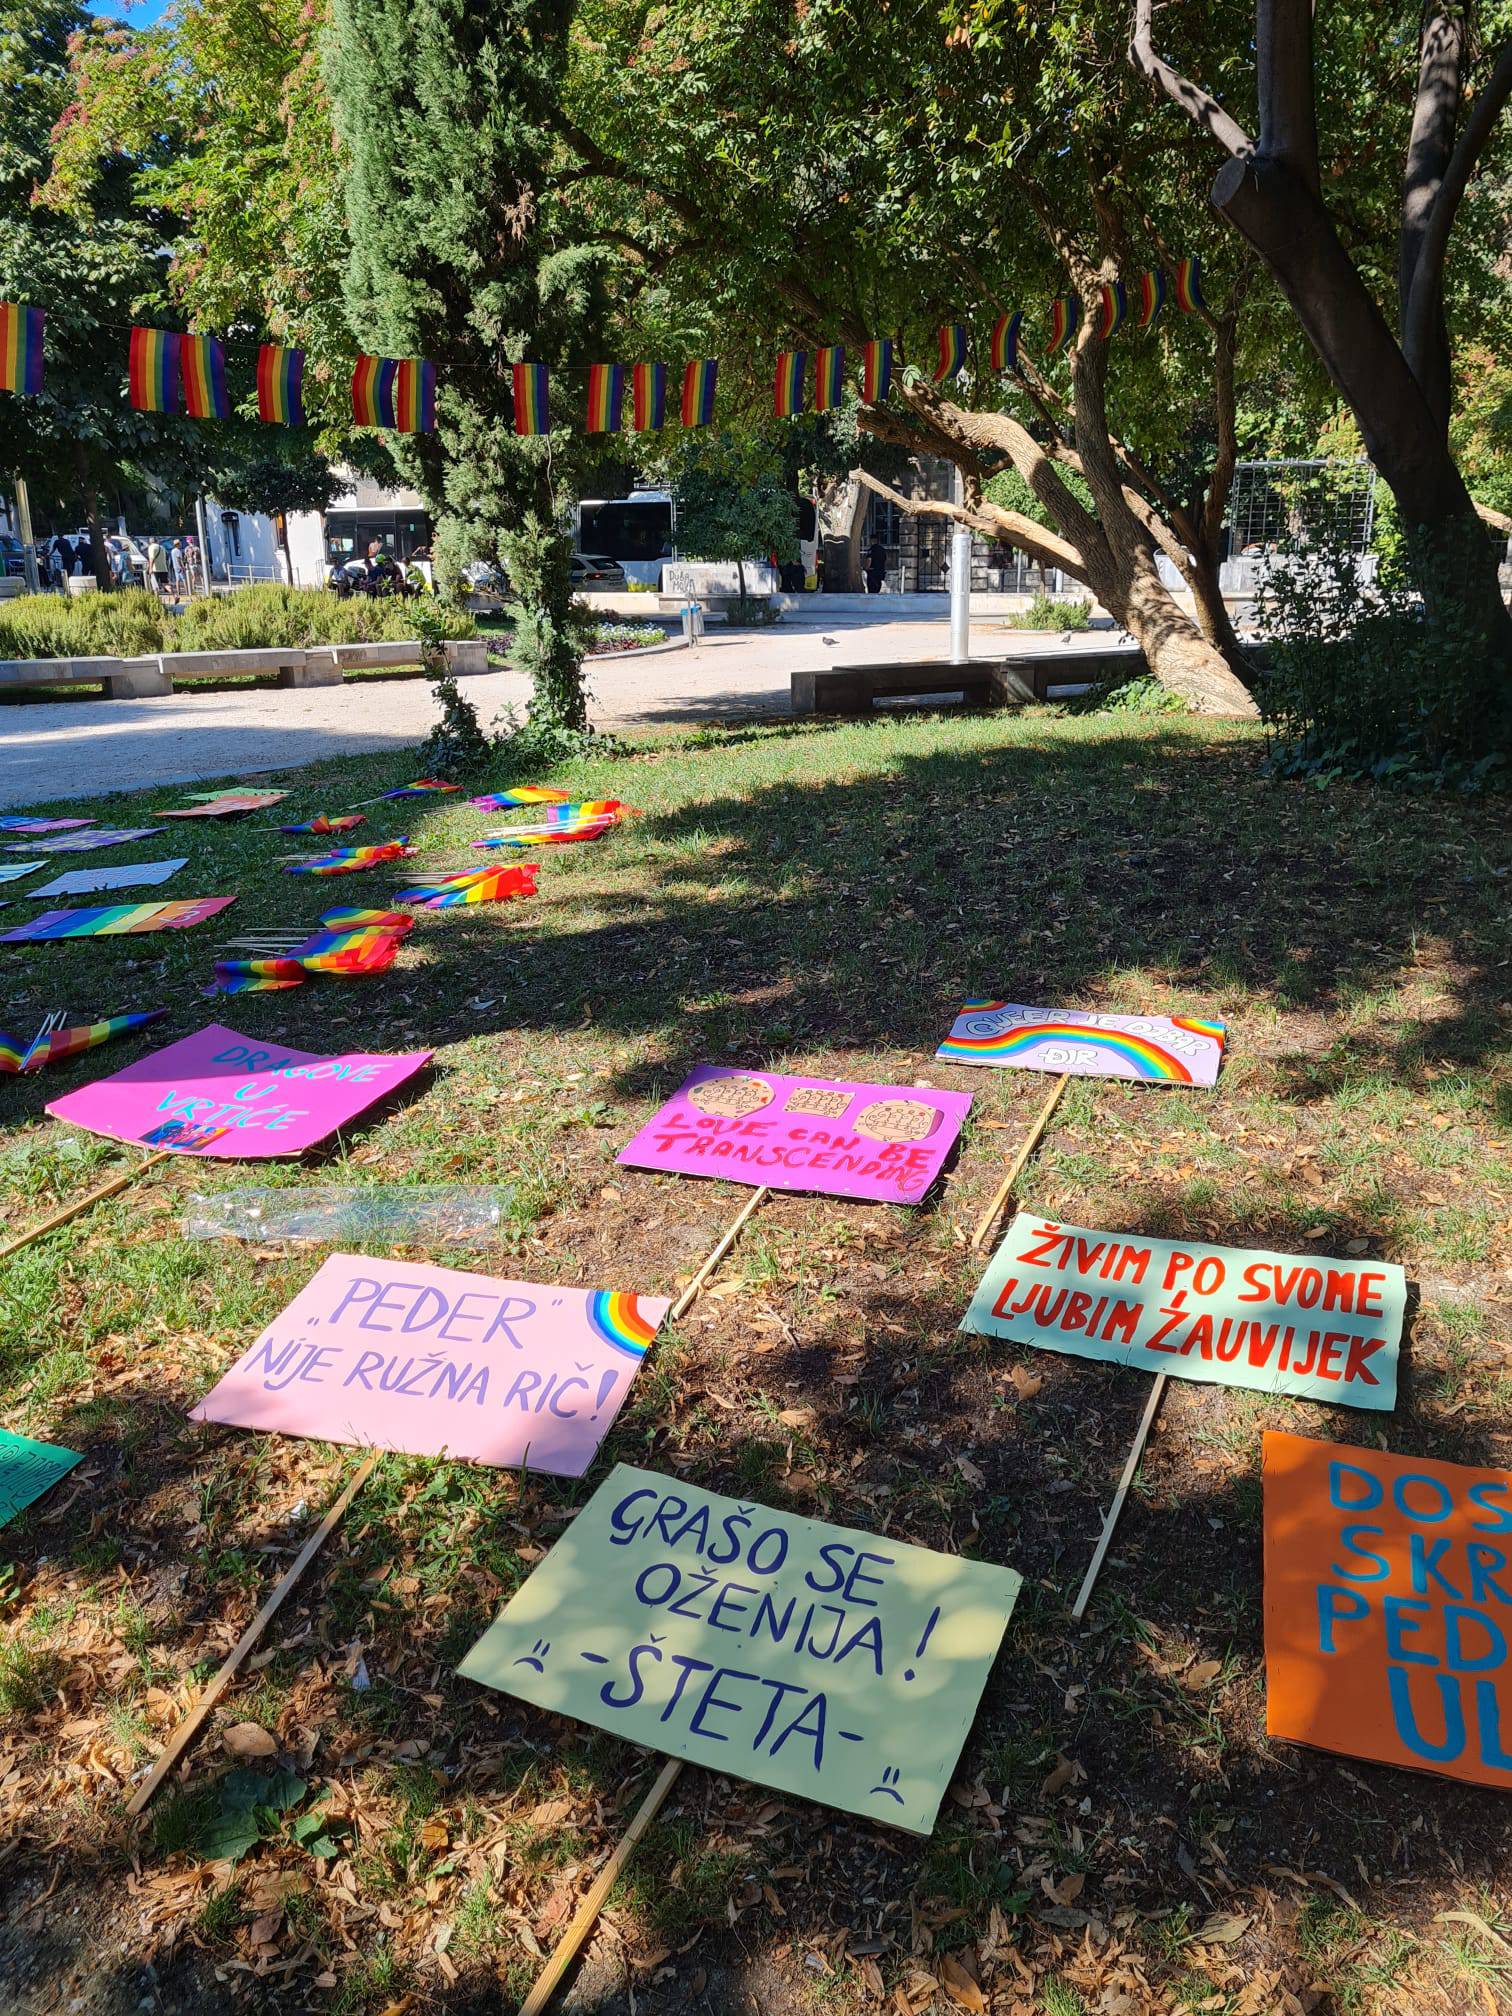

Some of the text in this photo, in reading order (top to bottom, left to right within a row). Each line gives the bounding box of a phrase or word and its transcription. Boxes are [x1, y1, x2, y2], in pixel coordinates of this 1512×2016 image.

[966, 1009, 1071, 1036] QUEER
[1077, 1014, 1121, 1027] JE
[211, 1045, 394, 1083] DRAGOVE
[234, 1082, 278, 1101] U
[653, 1132, 931, 1192] TRANSCENDING
[661, 1112, 778, 1138] LOVE
[878, 1141, 936, 1170] BE
[1015, 1223, 1387, 1318] ŽIVIM PO SVOME
[991, 1277, 1144, 1344] LJUBIM
[342, 1350, 490, 1406] RUŽNA
[503, 1361, 620, 1422] RIČ!
[609, 1488, 896, 1607] GRAŠO SE
